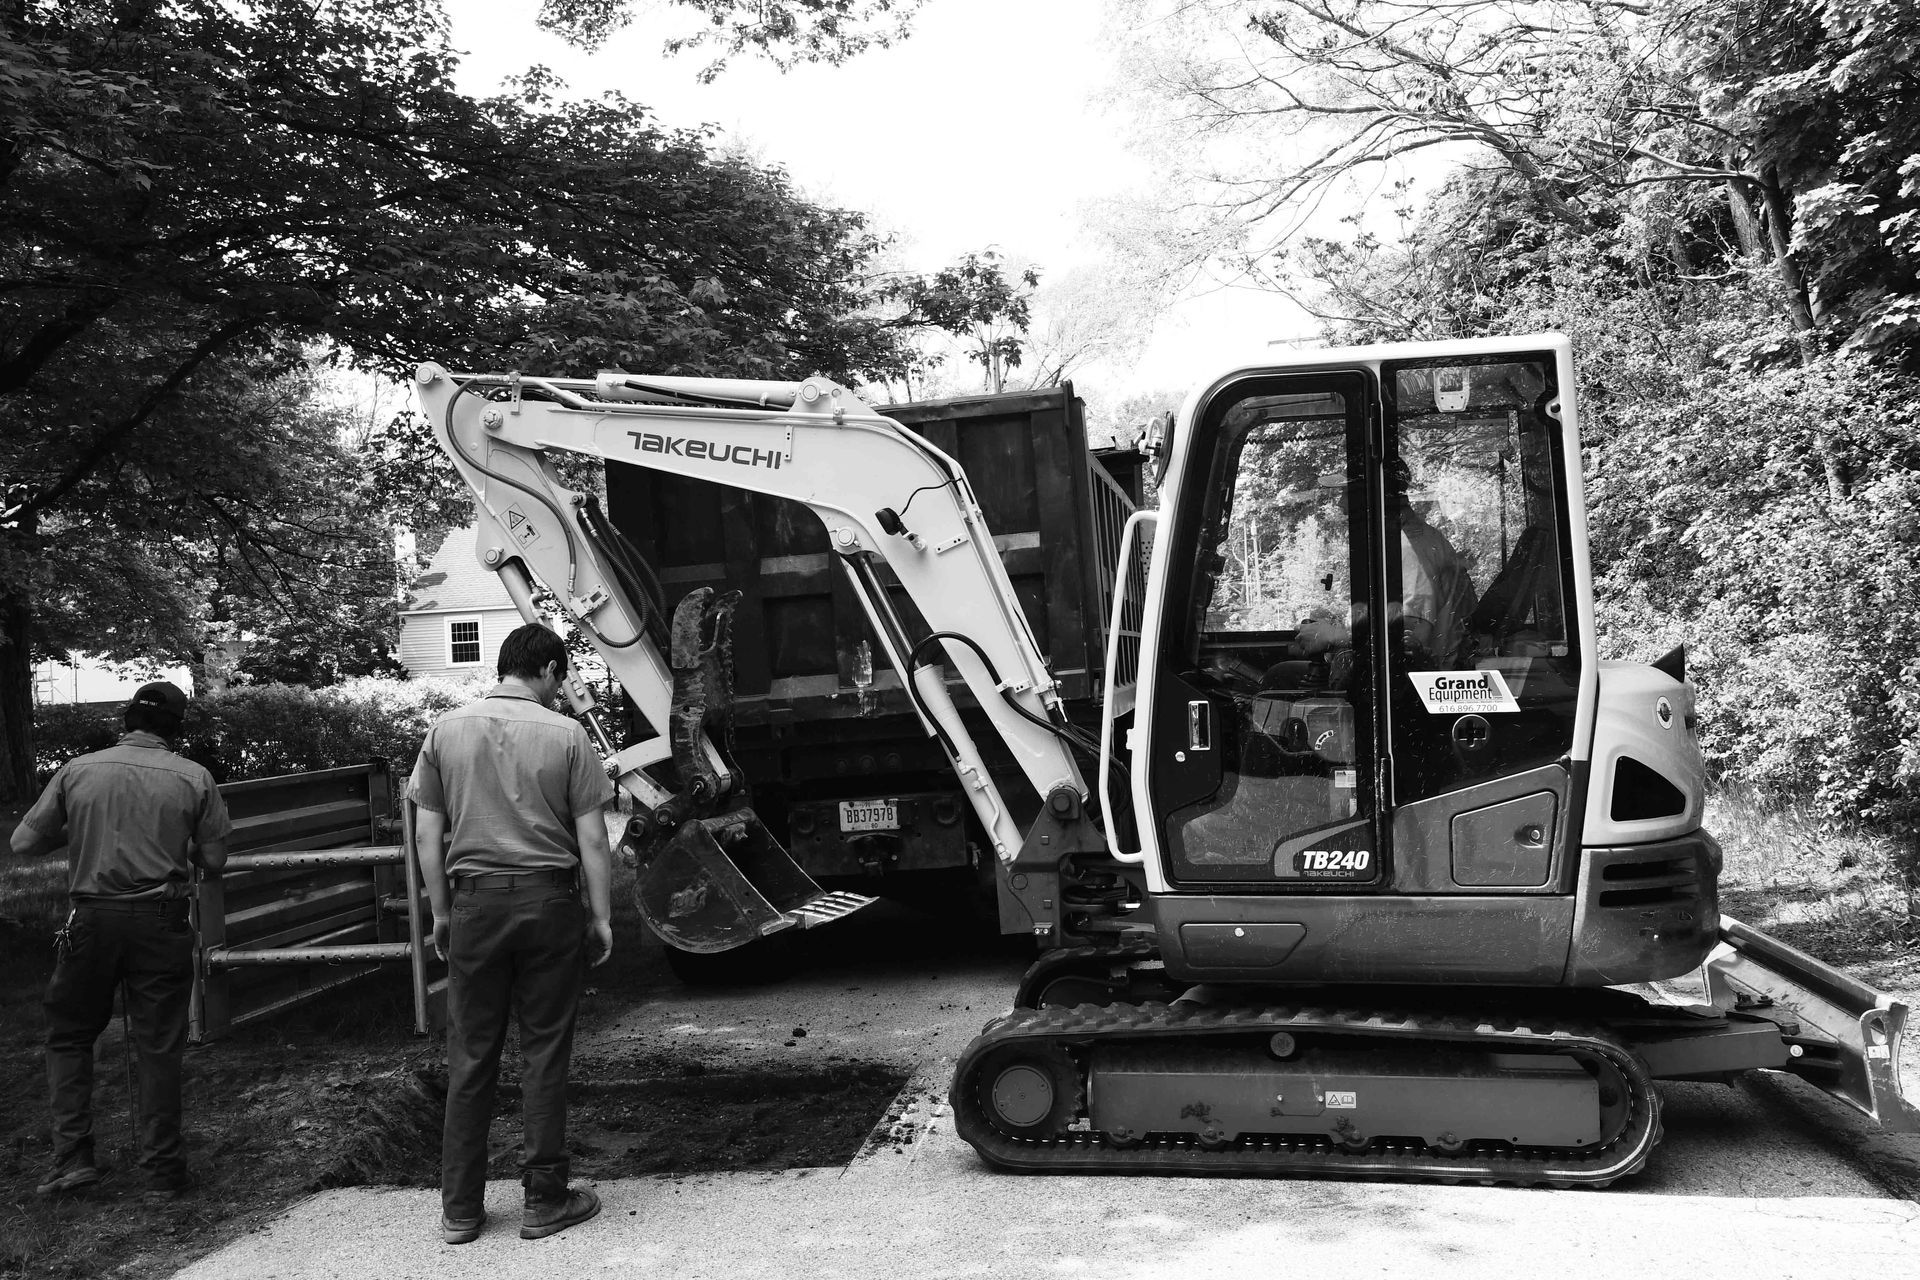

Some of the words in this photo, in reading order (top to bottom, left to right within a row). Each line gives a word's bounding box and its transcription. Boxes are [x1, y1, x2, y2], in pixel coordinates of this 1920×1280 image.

[1435, 675, 1489, 690] Grand
[1429, 687, 1493, 703] Equipment
[1439, 704, 1498, 713] 616.896.7700
[1303, 850, 1370, 870] TB240
